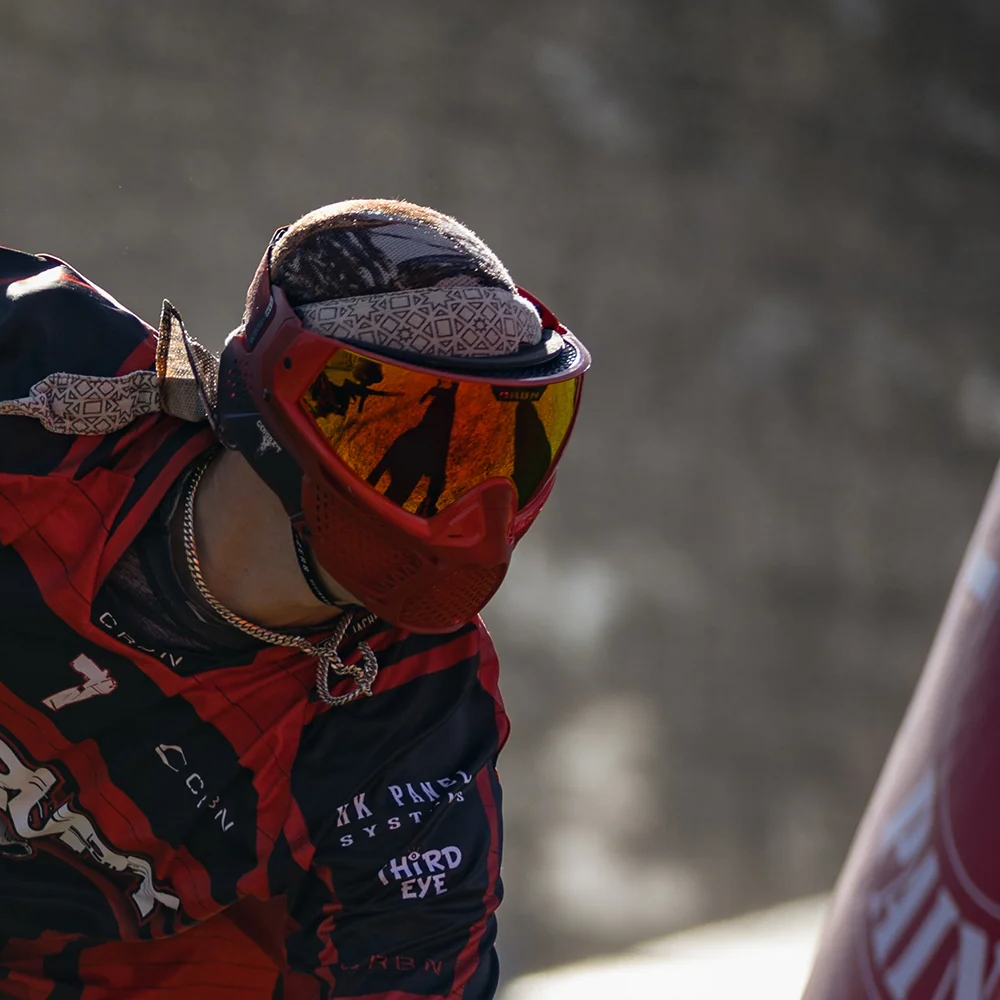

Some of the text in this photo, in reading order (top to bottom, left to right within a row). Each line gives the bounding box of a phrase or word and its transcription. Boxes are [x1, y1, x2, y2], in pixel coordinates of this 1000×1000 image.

[42, 653, 118, 711] 7
[340, 791, 465, 847] SYSTS
[400, 872, 448, 899] EYE
